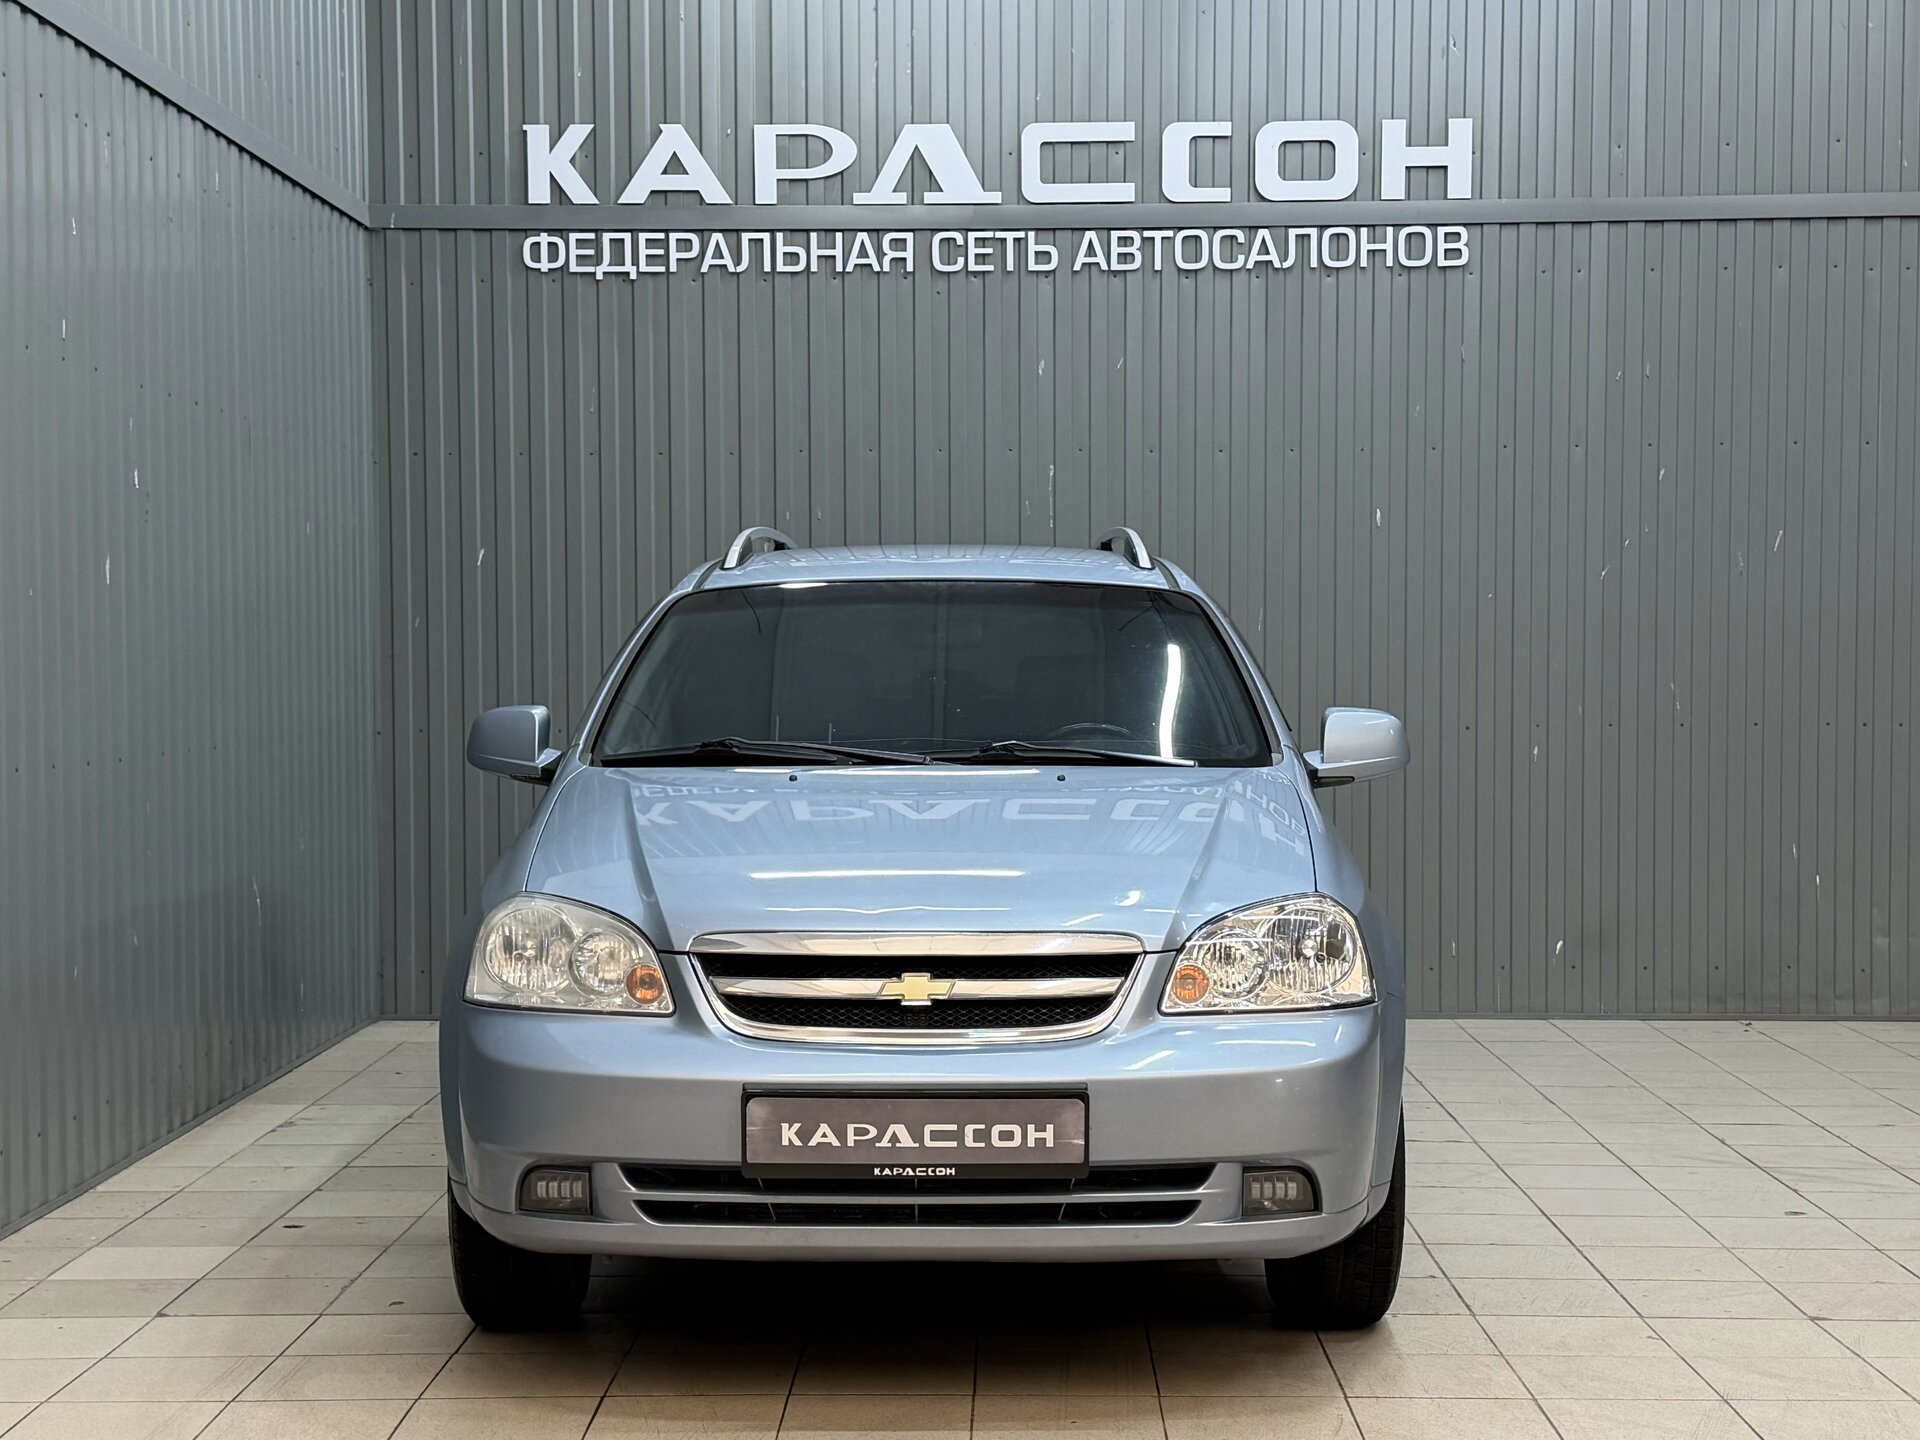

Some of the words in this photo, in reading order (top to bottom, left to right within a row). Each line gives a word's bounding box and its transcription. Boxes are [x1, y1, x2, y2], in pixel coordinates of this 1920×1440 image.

[522, 230, 914, 280] ФЕДЕРАЛЬНАЯ
[931, 230, 1058, 272] СЕТЬ
[1072, 225, 1470, 272] АВТОСАЛОНОВ
